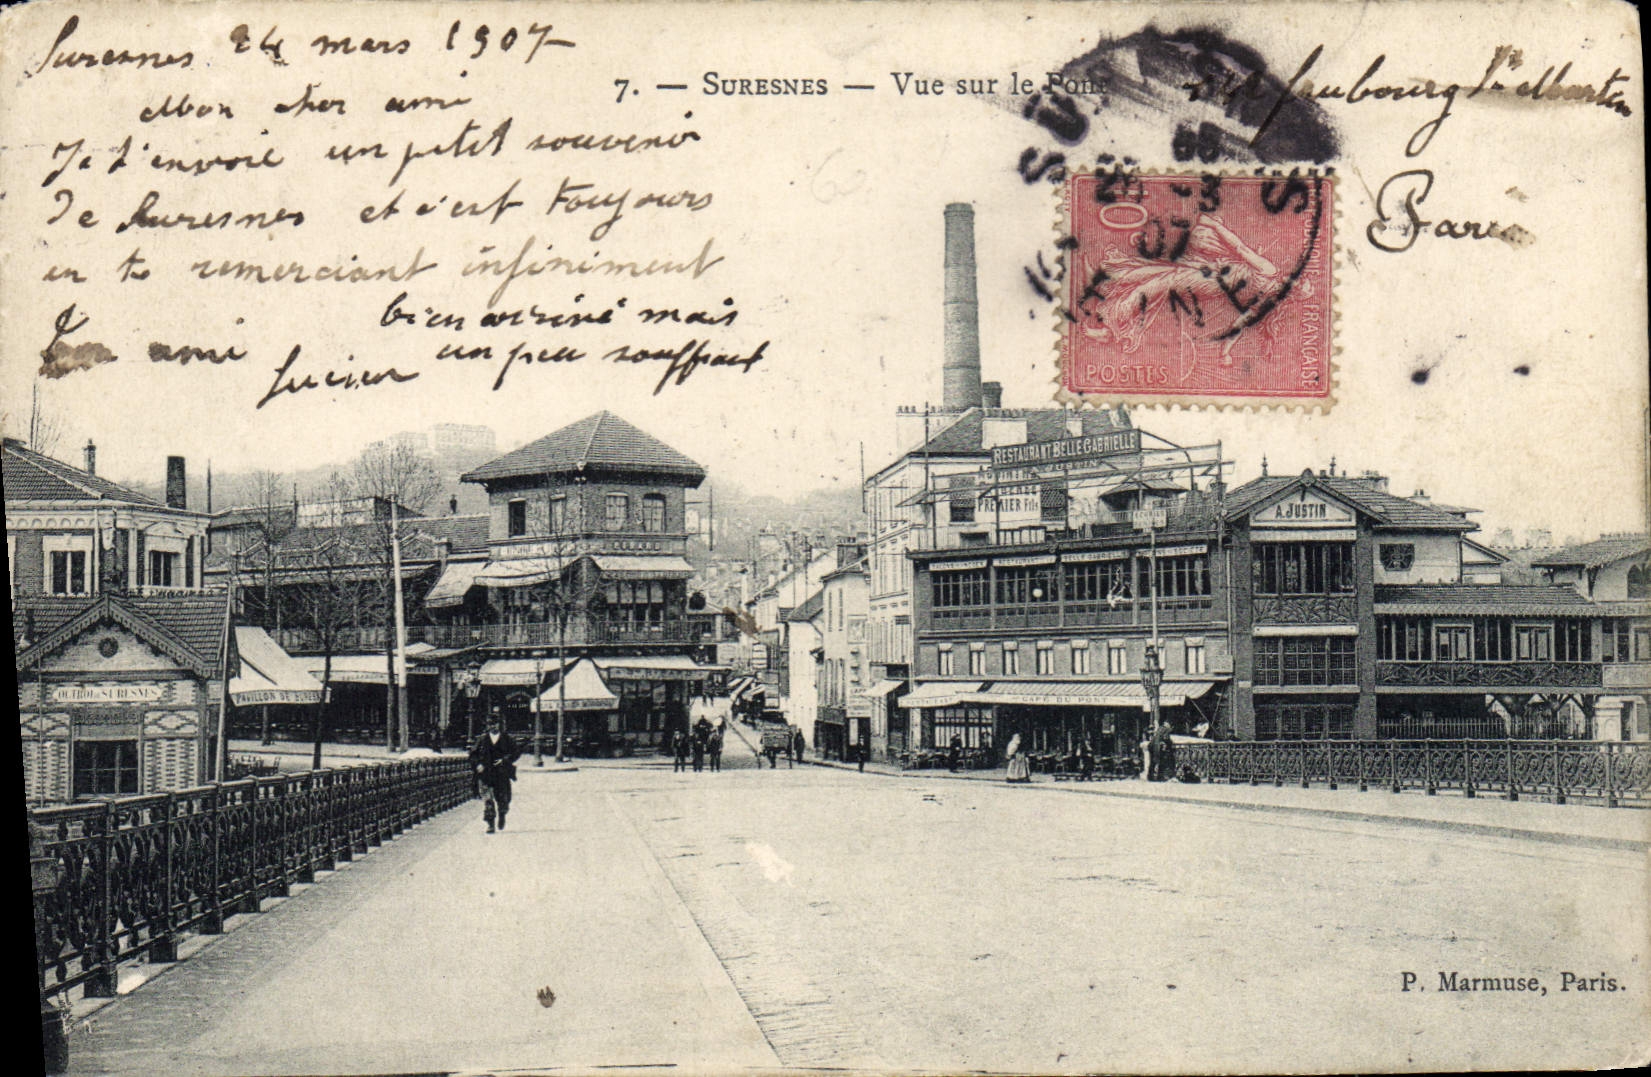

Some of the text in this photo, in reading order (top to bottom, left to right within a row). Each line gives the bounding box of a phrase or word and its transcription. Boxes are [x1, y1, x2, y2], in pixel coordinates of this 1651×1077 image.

[26, 15, 194, 79] Suresnes
[311, 33, 411, 55] mars
[446, 20, 576, 63] 1907
[273, 83, 347, 118] cher
[385, 70, 472, 112] ami
[42, 138, 91, 187] Je
[325, 142, 388, 165] un
[388, 117, 513, 186] petit
[526, 110, 701, 153] souvenir
[116, 191, 305, 233] Suresnes
[360, 189, 409, 223] et
[416, 180, 523, 224] c'est
[190, 247, 437, 284] remerciant
[461, 235, 725, 308] infiniment
[379, 292, 464, 331] bien
[642, 297, 738, 327] mais
[436, 342, 493, 361] un
[492, 340, 587, 390] peu
[1086, 365, 1169, 385] POSTES
[993, 443, 1052, 465] RESTAURANT
[1083, 433, 1136, 453] GABRIELLE
[1286, 503, 1327, 518] JUSTIN
[1078, 696, 1109, 704] PONT
